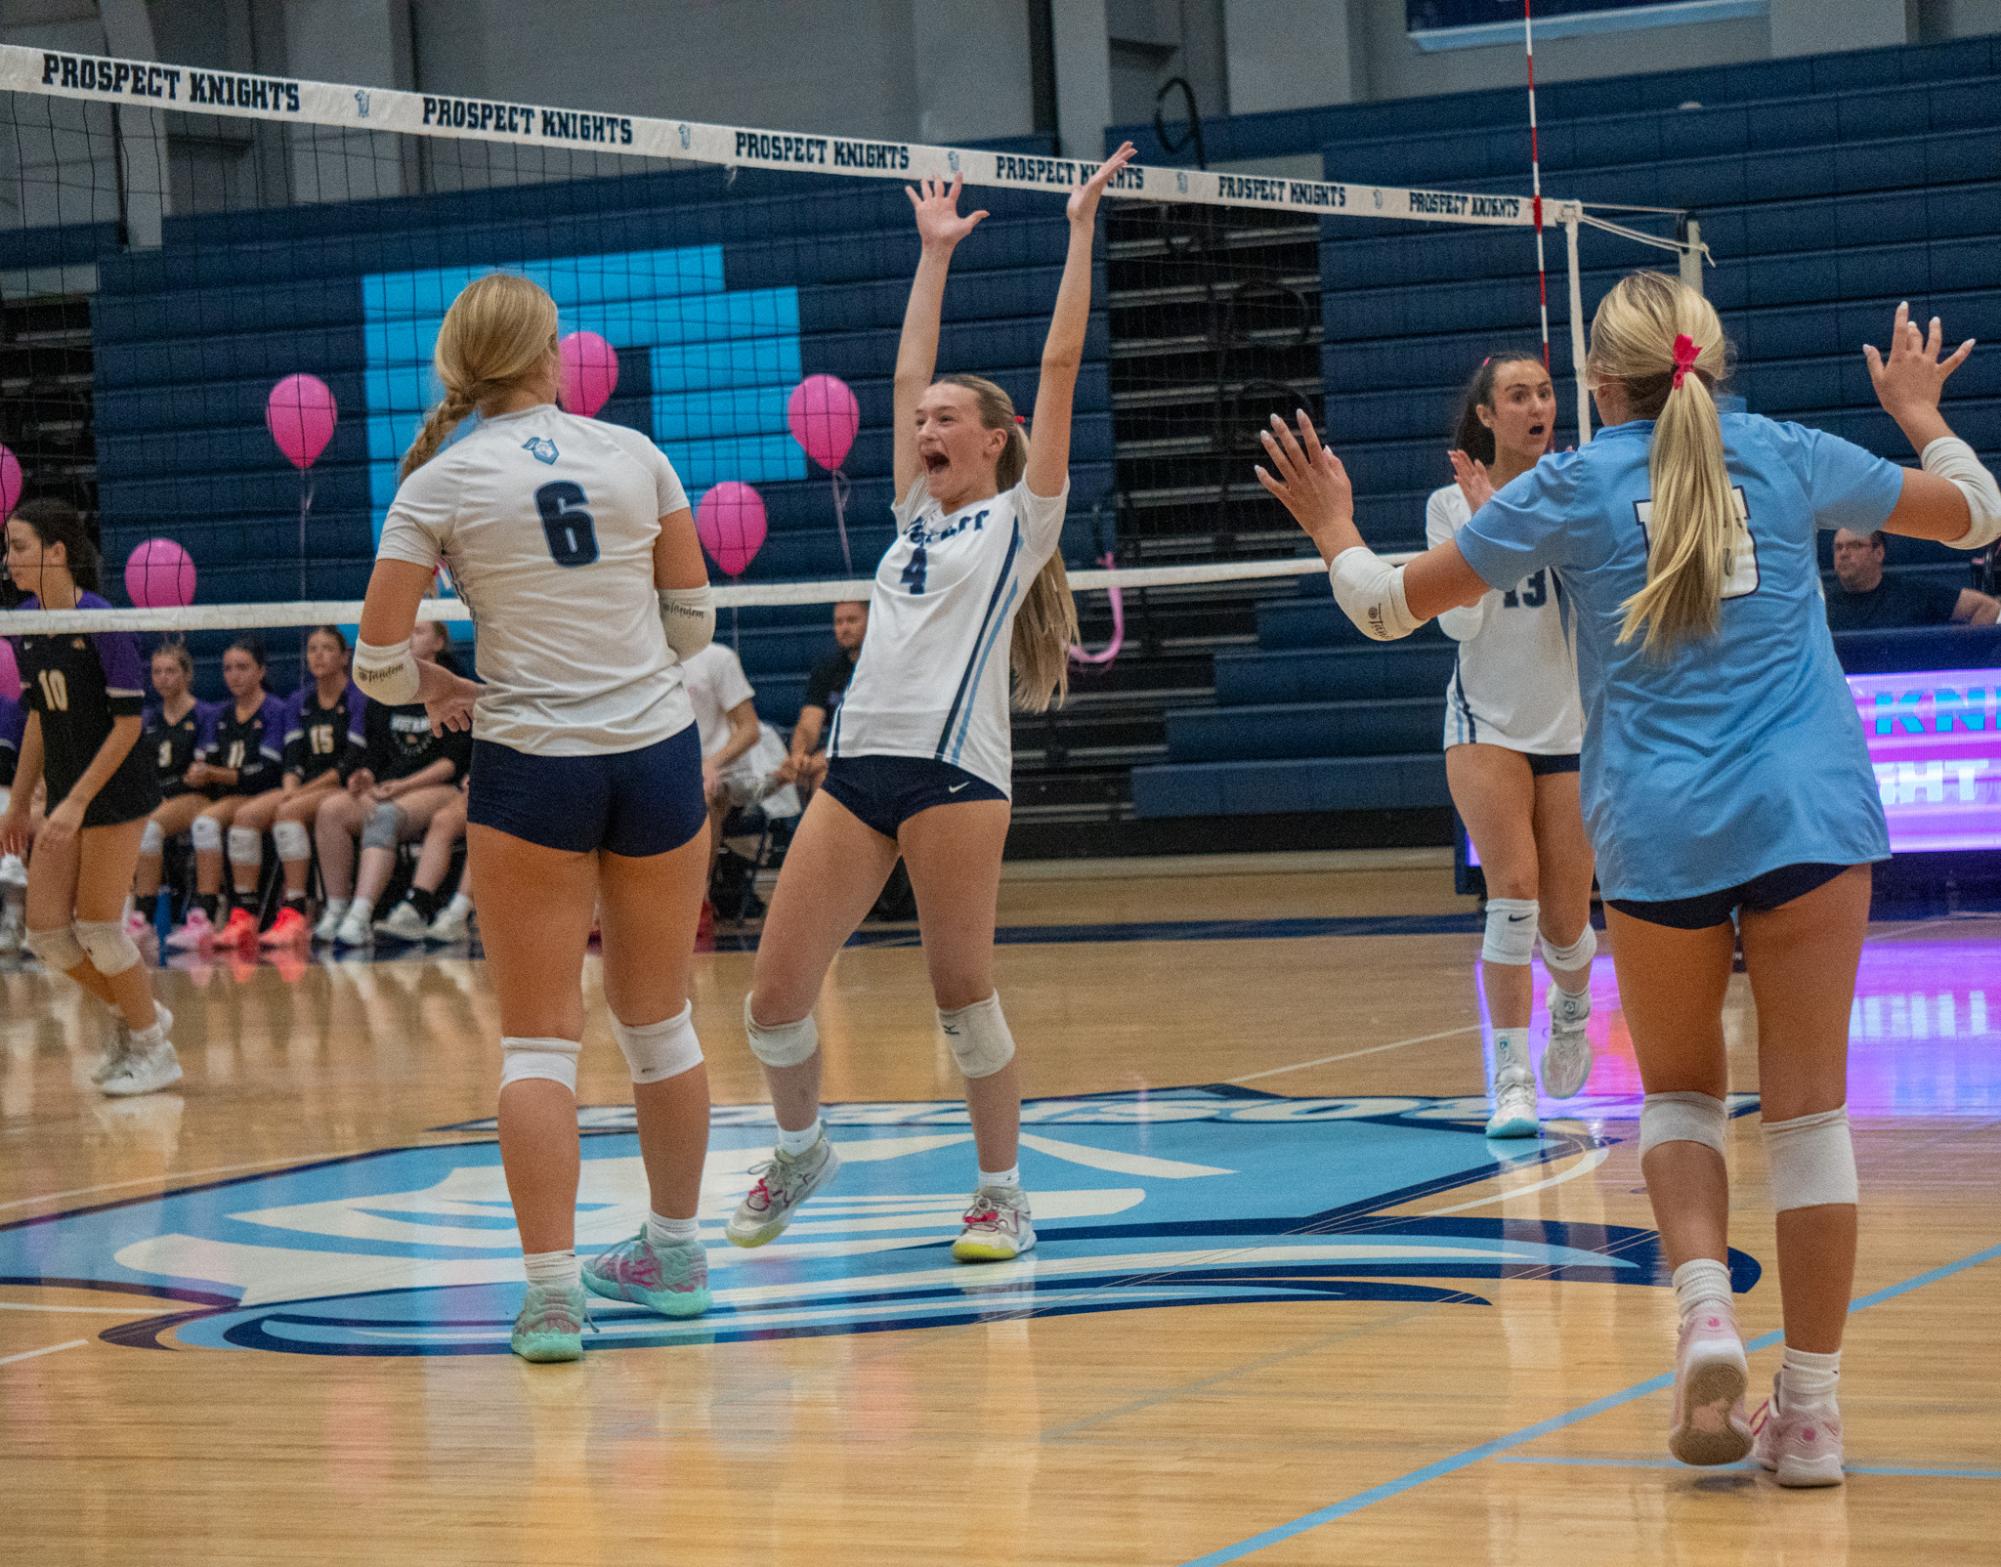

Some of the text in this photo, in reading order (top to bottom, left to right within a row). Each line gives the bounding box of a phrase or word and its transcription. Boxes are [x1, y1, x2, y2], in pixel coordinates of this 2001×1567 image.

[42, 53, 301, 114] PROSPECT KNIGHTS
[423, 97, 634, 145] PROSPECT KNIGHTS
[735, 131, 910, 171] PROSPECT KNIGHTS
[996, 155, 1145, 190] PROSPECT KHTS
[1218, 175, 1347, 208] PROSPECT KNIGHTS
[1409, 191, 1520, 219] PROSPECT KNIGHTS
[534, 479, 600, 568] 6
[900, 547, 928, 595] 4
[38, 668, 69, 712] 10
[309, 724, 335, 755] 15
